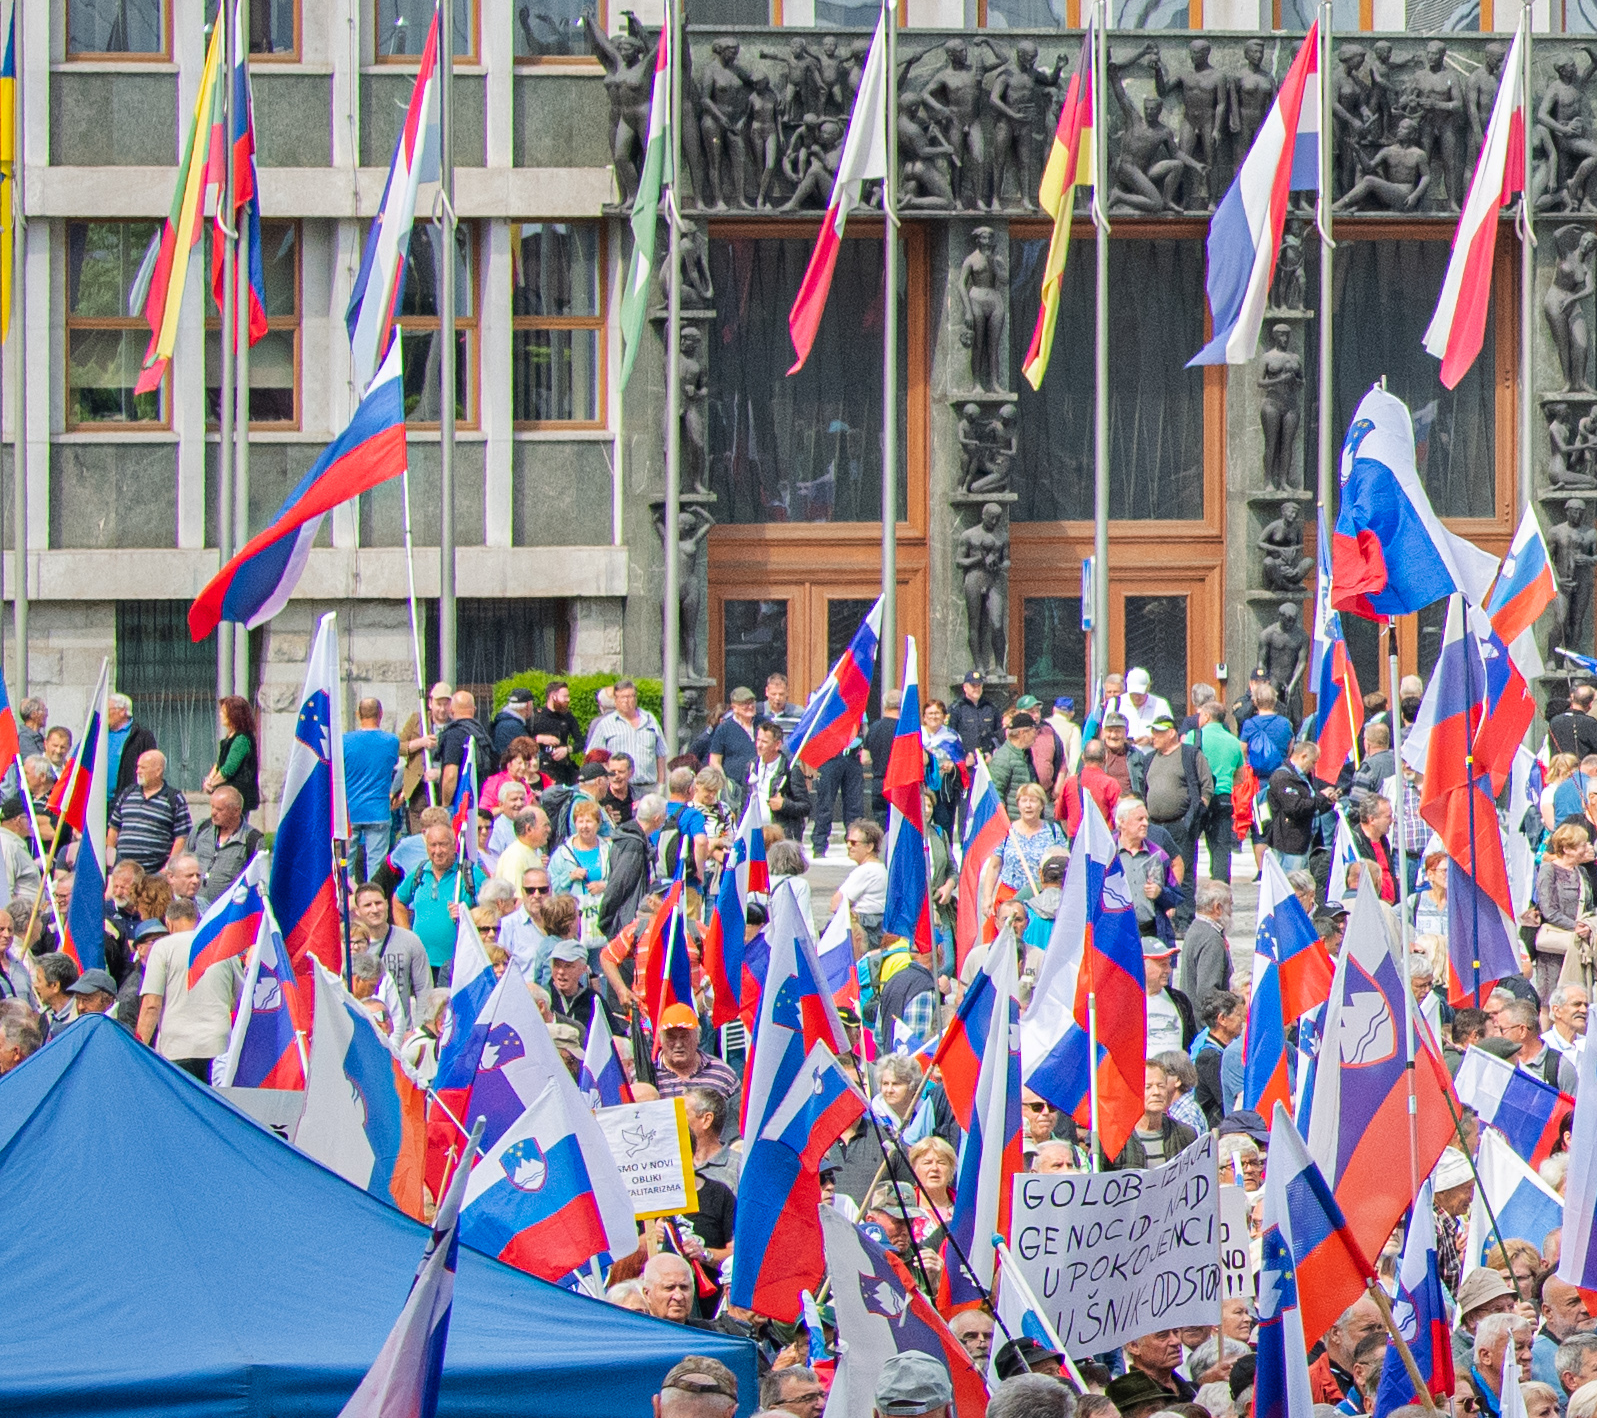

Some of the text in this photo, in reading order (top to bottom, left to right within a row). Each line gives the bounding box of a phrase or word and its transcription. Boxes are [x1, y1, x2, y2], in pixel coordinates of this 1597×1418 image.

[649, 1158, 674, 1170] NOVI
[631, 1173, 662, 1185] OBLIKI
[1043, 1213, 1214, 1299] UPOKOJENCI
